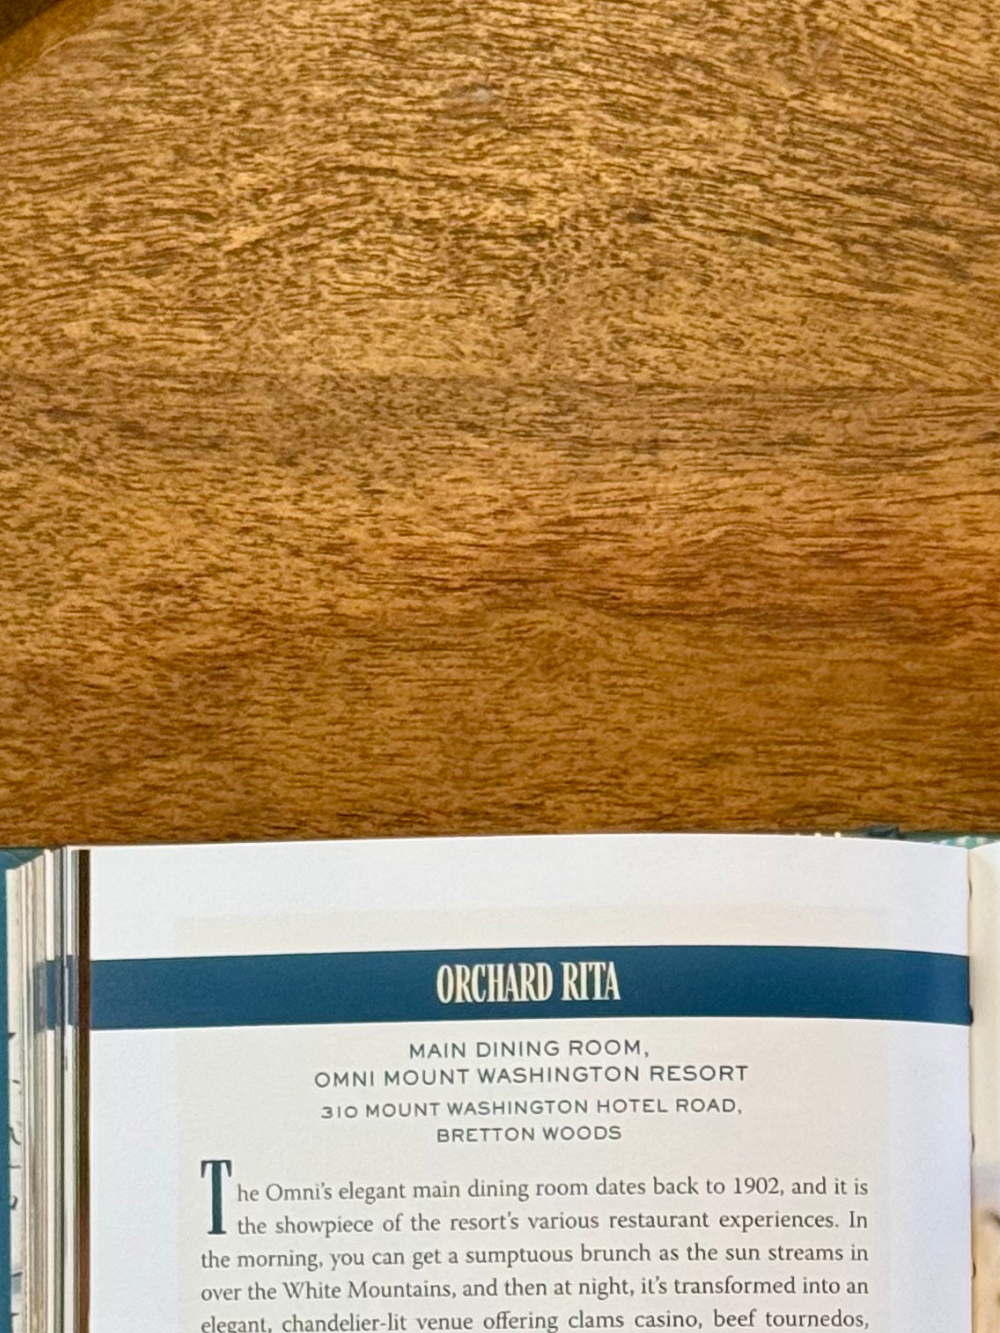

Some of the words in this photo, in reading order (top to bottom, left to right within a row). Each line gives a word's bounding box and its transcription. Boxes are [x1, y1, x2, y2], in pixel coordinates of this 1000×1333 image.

[436, 963, 554, 1004] ORCHARD
[560, 961, 621, 1001] RITA
[410, 1041, 465, 1059] MAIN
[477, 1039, 559, 1058] DINING
[569, 1038, 649, 1058] ROOM,
[315, 1071, 374, 1088] OMNI
[385, 1068, 469, 1087] MOUNT
[477, 1065, 639, 1084] WASHINGTON
[650, 1065, 748, 1082] RESORT
[321, 1105, 358, 1120] 310
[366, 1101, 440, 1118] MOUNT
[447, 1099, 587, 1116] WASHINGTON
[597, 1098, 668, 1114] HOTEL
[676, 1097, 742, 1115] ROAD,
[437, 1127, 534, 1143] BRETTON
[542, 1125, 621, 1141] WOODS
[339, 1181, 406, 1206] elegant
[413, 1181, 460, 1199] main
[468, 1178, 529, 1203] dining
[536, 1183, 587, 1196] room
[596, 1177, 646, 1196] dates
[653, 1176, 699, 1196] back
[706, 1178, 725, 1195] to
[734, 1177, 784, 1196] 1902,
[792, 1175, 826, 1195] and
[835, 1177, 847, 1196] it
[854, 1178, 868, 1196] is
[238, 1215, 267, 1235] the
[276, 1215, 373, 1239] showpiece
[383, 1212, 403, 1232] of
[411, 1213, 440, 1232] the
[528, 1211, 599, 1230] various
[609, 1212, 709, 1229] restaurant
[719, 1210, 839, 1233] experiences.
[850, 1210, 867, 1229] In
[201, 1288, 242, 1302] over
[248, 1281, 276, 1300] the
[282, 1281, 341, 1300] White
[348, 1280, 456, 1298] Mountains,
[463, 1277, 498, 1296] and
[504, 1277, 547, 1296] then
[554, 1279, 572, 1296] at
[579, 1276, 634, 1301] night,
[674, 1275, 796, 1295] transformed
[803, 1276, 840, 1295] into
[847, 1281, 868, 1295] an
[282, 1312, 407, 1333] chandelier-lit
[416, 1317, 473, 1331] venue
[483, 1310, 558, 1333] offering
[568, 1309, 624, 1329] clams
[635, 1309, 702, 1330] casino,
[714, 1308, 757, 1328] beef
[766, 1308, 868, 1330] tournedos,
